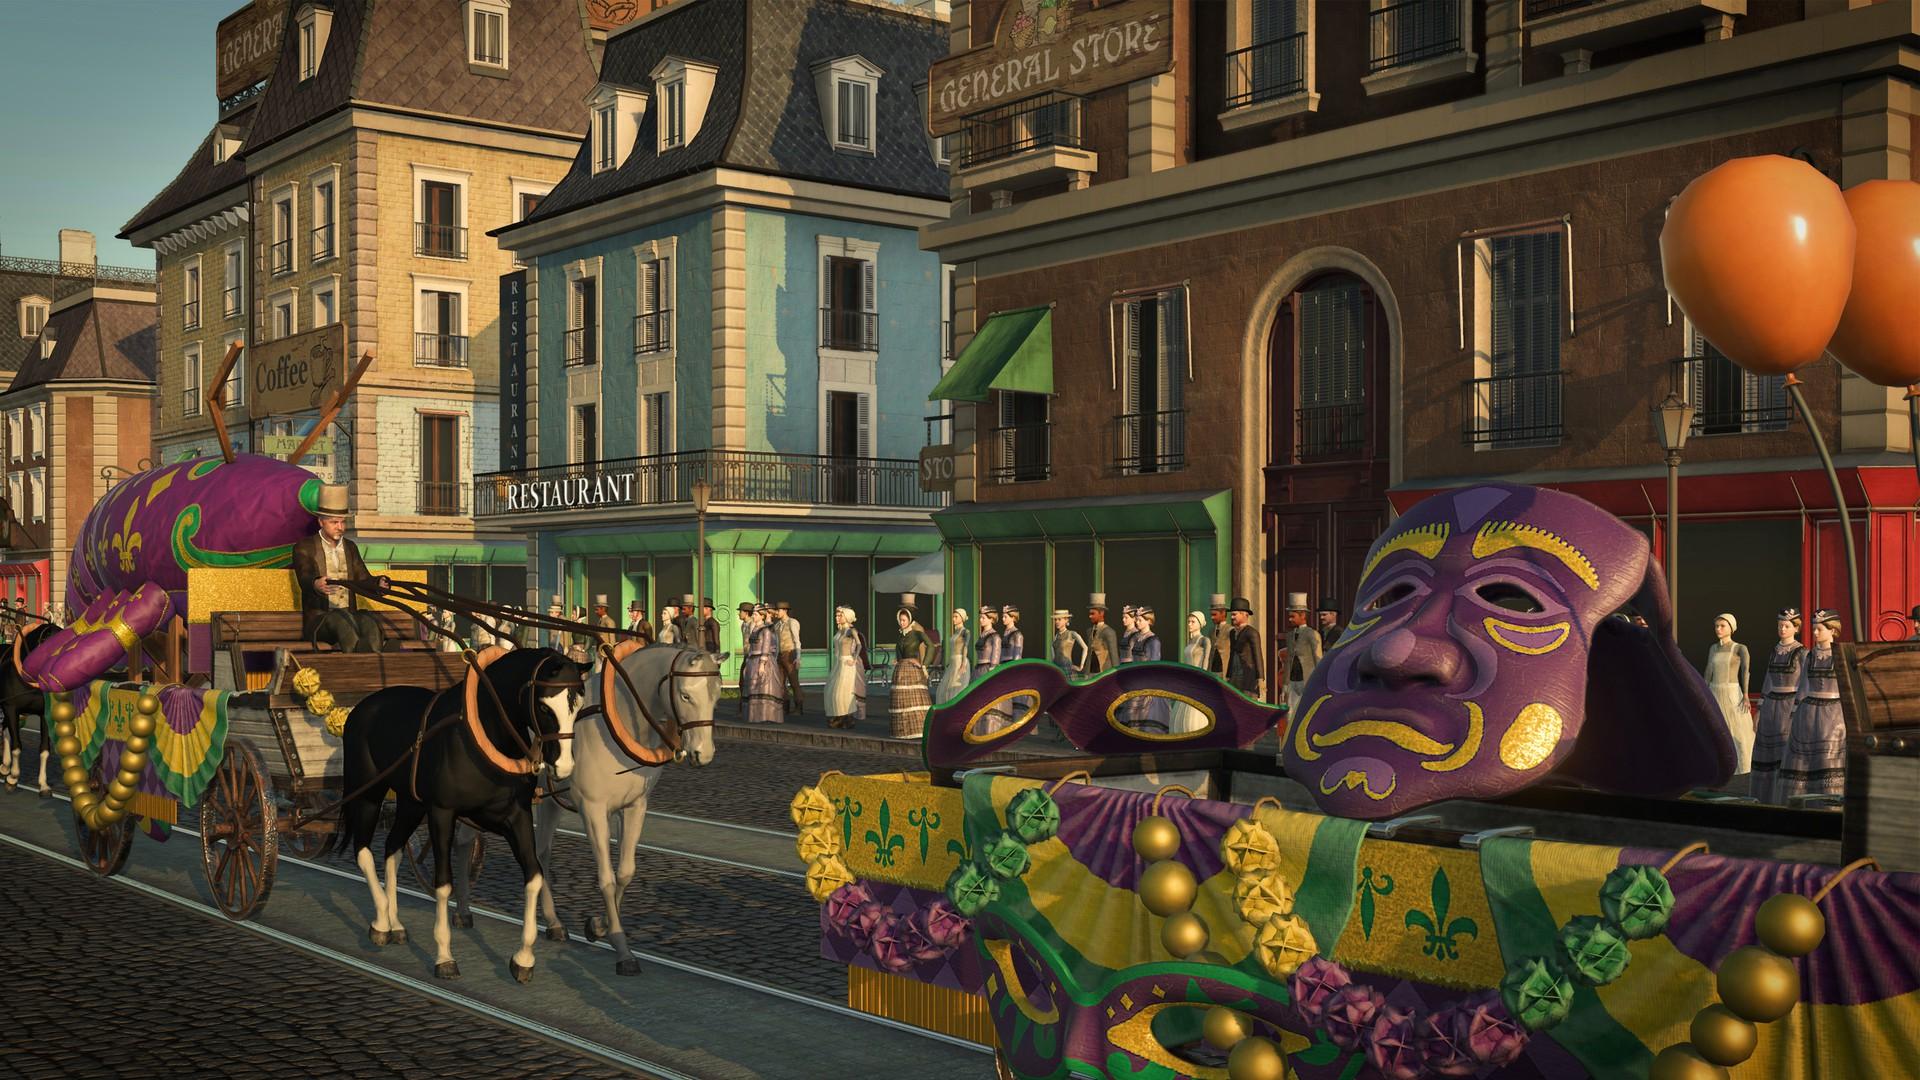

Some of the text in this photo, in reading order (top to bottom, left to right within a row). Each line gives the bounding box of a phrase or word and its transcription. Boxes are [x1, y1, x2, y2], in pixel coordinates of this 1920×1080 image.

[940, 14, 1161, 112] GENERAL STORE
[255, 353, 309, 394] Coffee
[507, 473, 635, 510] RESTAURANT
